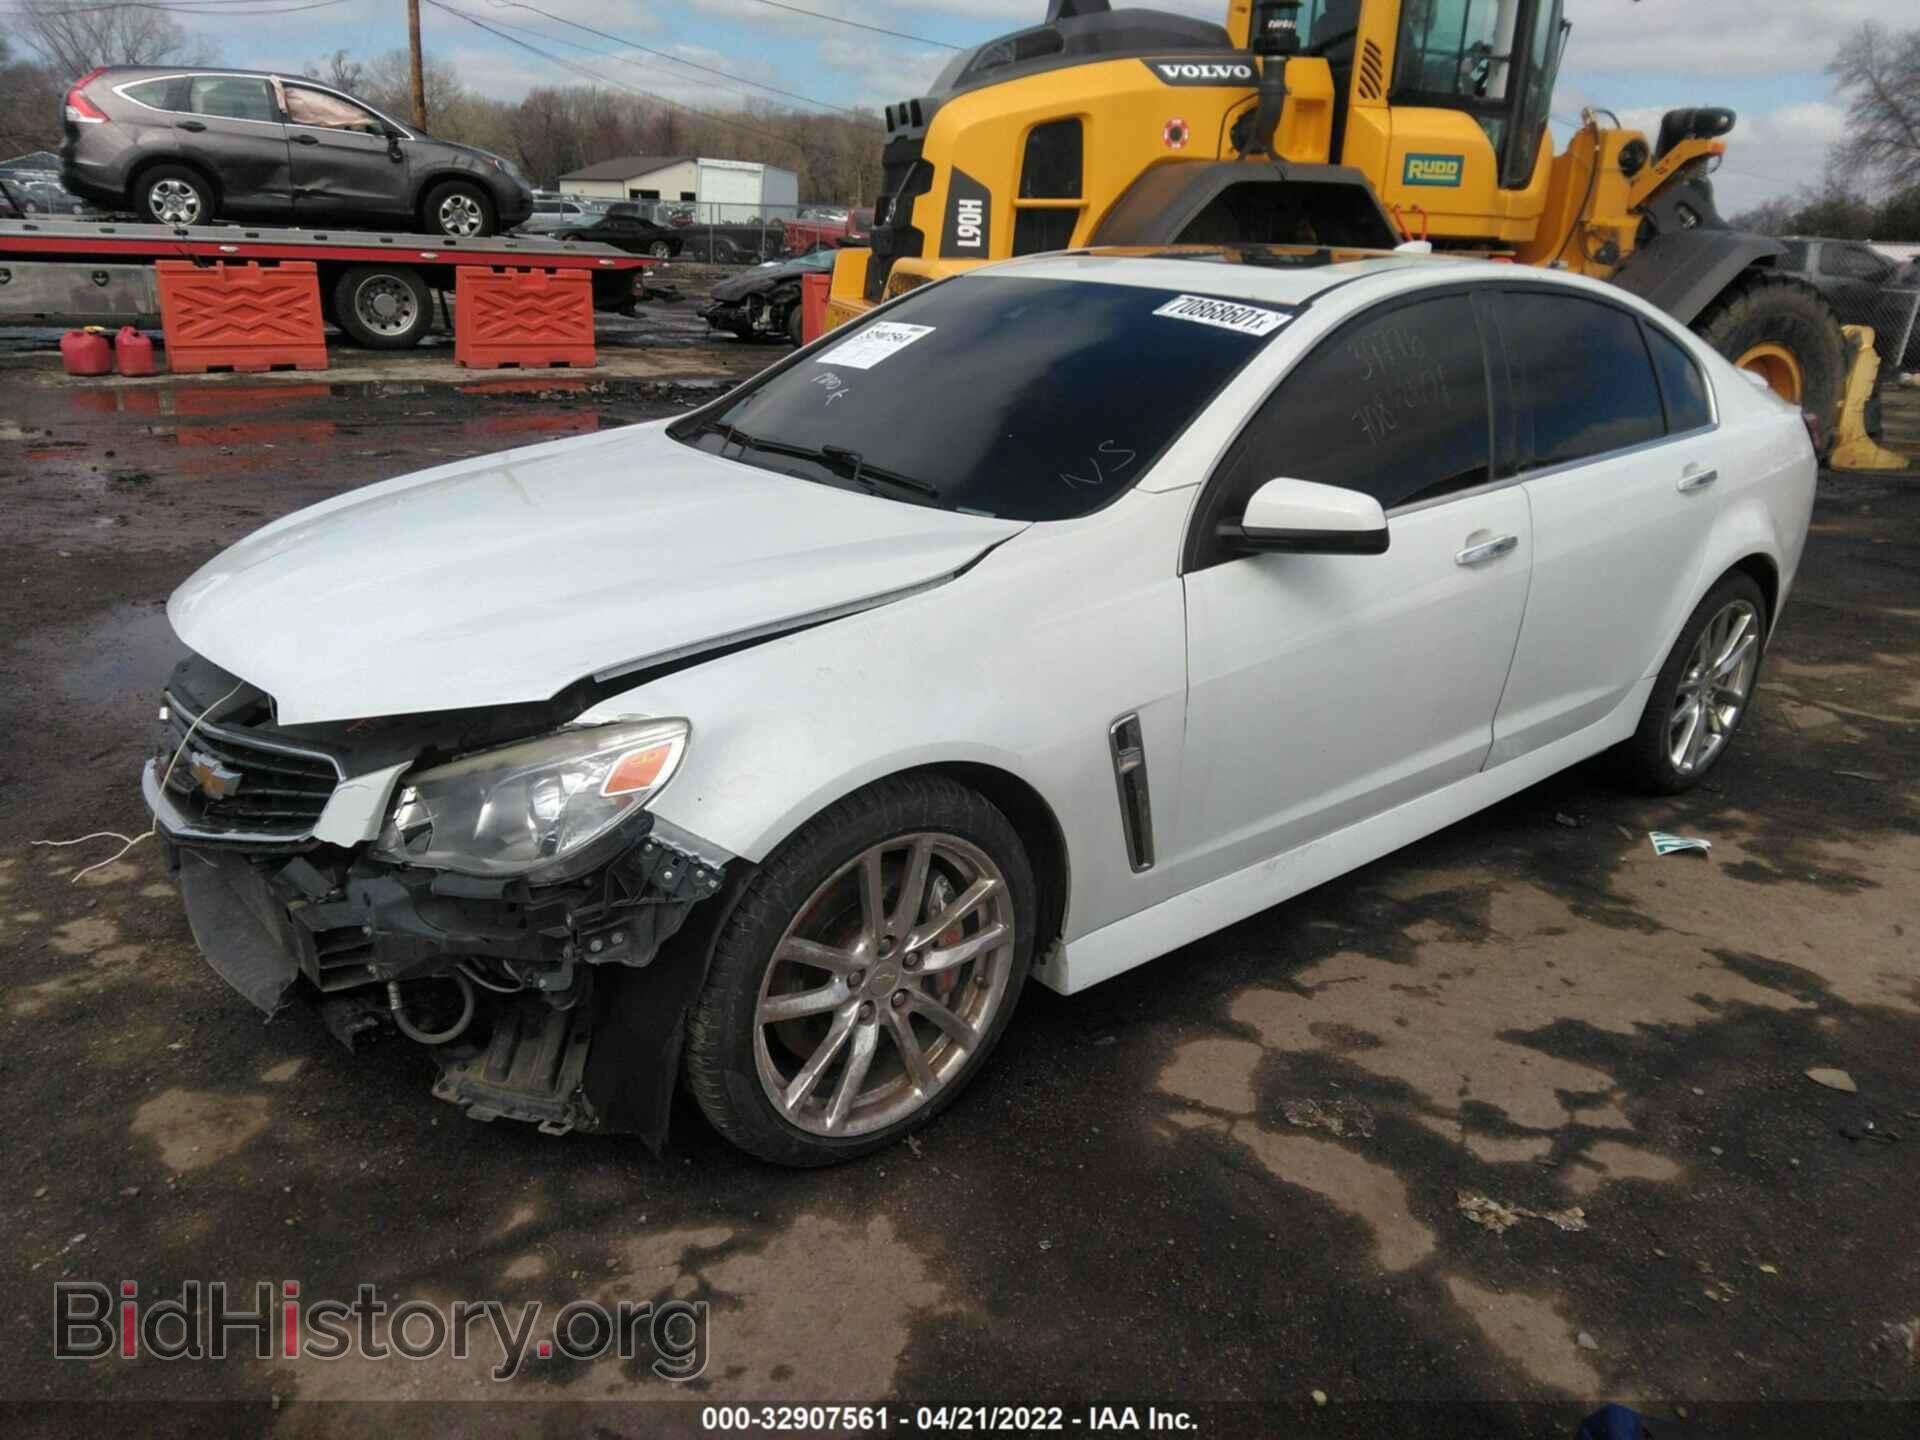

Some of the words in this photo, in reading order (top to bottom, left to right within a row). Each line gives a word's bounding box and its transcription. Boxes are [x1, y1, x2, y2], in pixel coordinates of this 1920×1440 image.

[1158, 64, 1252, 79] VOLVO
[1407, 159, 1458, 179] RUDD
[957, 199, 982, 247] L90H
